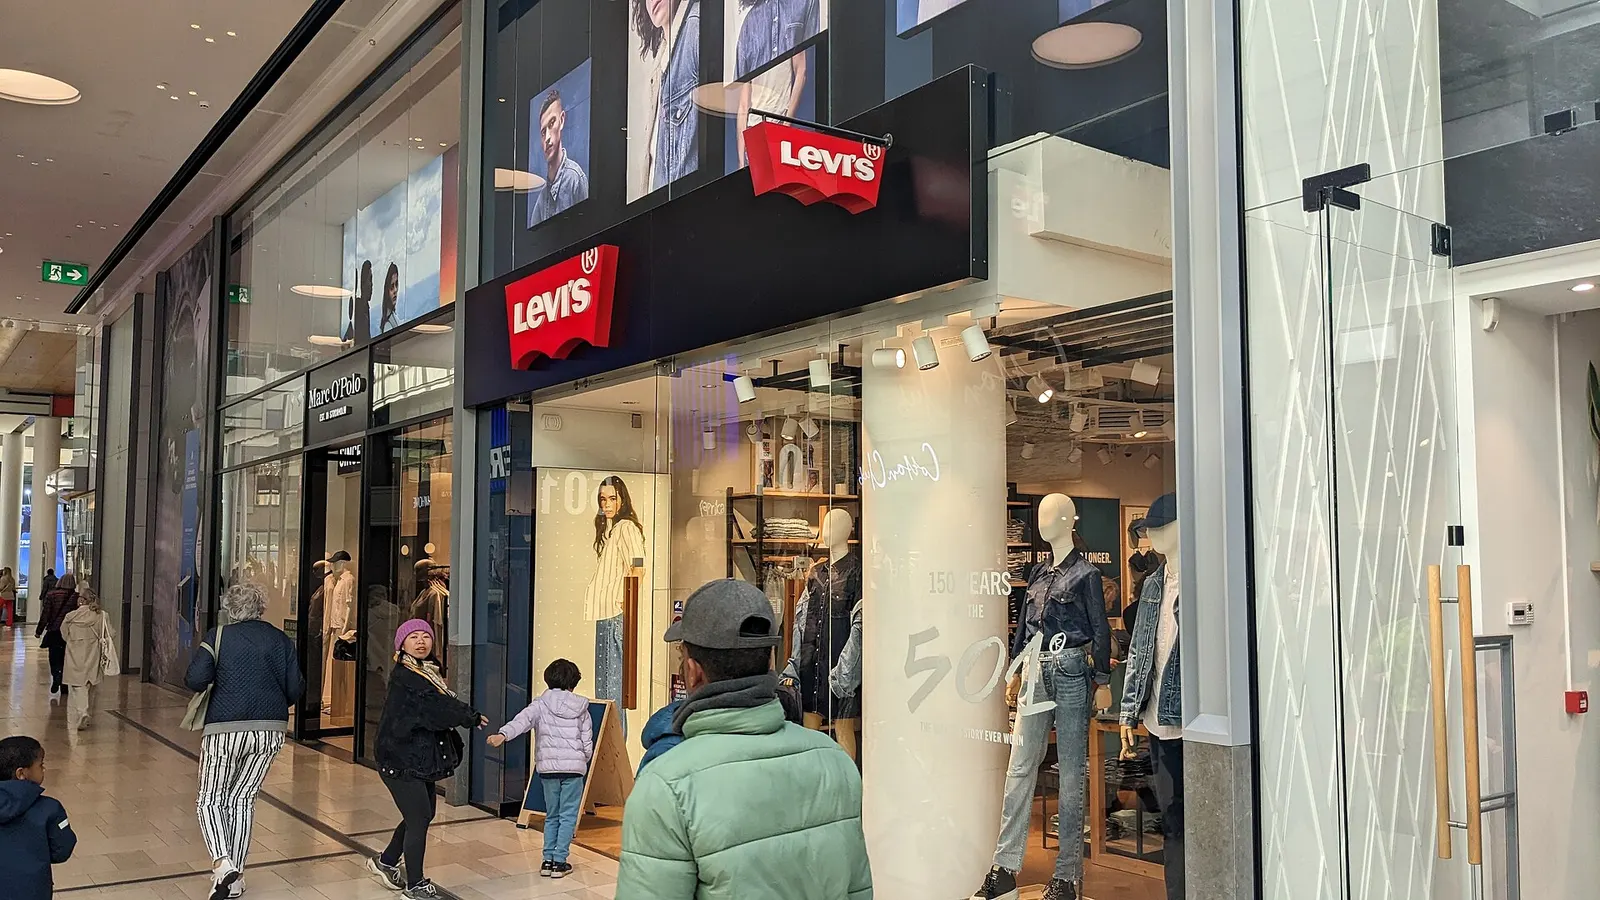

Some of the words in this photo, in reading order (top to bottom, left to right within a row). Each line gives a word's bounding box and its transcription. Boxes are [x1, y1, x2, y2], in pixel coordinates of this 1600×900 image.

[308, 388, 331, 410] Marc
[331, 372, 361, 401] O'Polo
[967, 604, 985, 619] THE
[984, 729, 1002, 743] EVER
